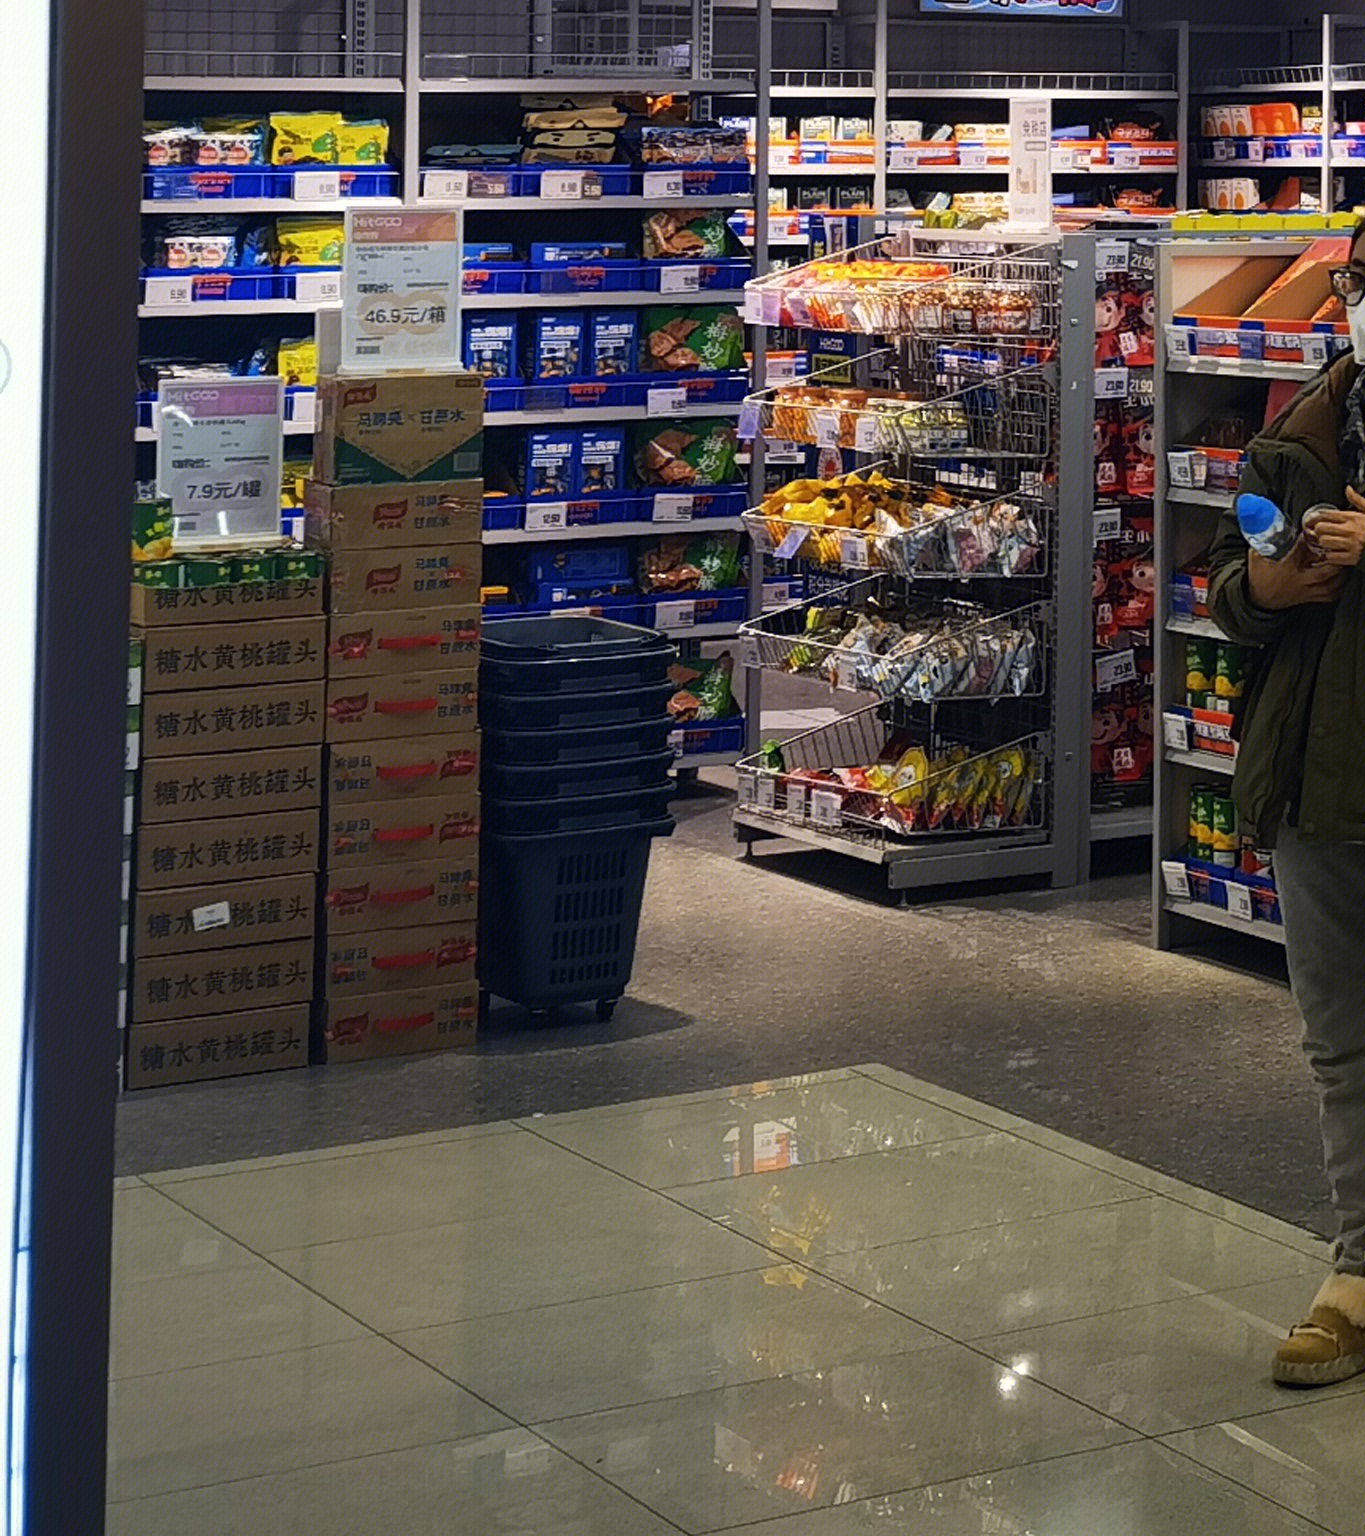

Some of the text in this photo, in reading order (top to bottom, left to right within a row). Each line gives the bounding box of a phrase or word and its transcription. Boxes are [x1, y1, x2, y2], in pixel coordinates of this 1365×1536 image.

[154, 637, 317, 675] 糖水黄桃罐头
[154, 700, 317, 739] 糖水黄桃罐头
[153, 767, 317, 807] 糖水黄桃罐头
[151, 831, 313, 873] 糖水黄桃罐头
[146, 896, 309, 939] 糖水桃罐头
[147, 961, 308, 1004] 糖水黄桃罐头
[140, 1028, 301, 1071] 糖水黄桃罐头
